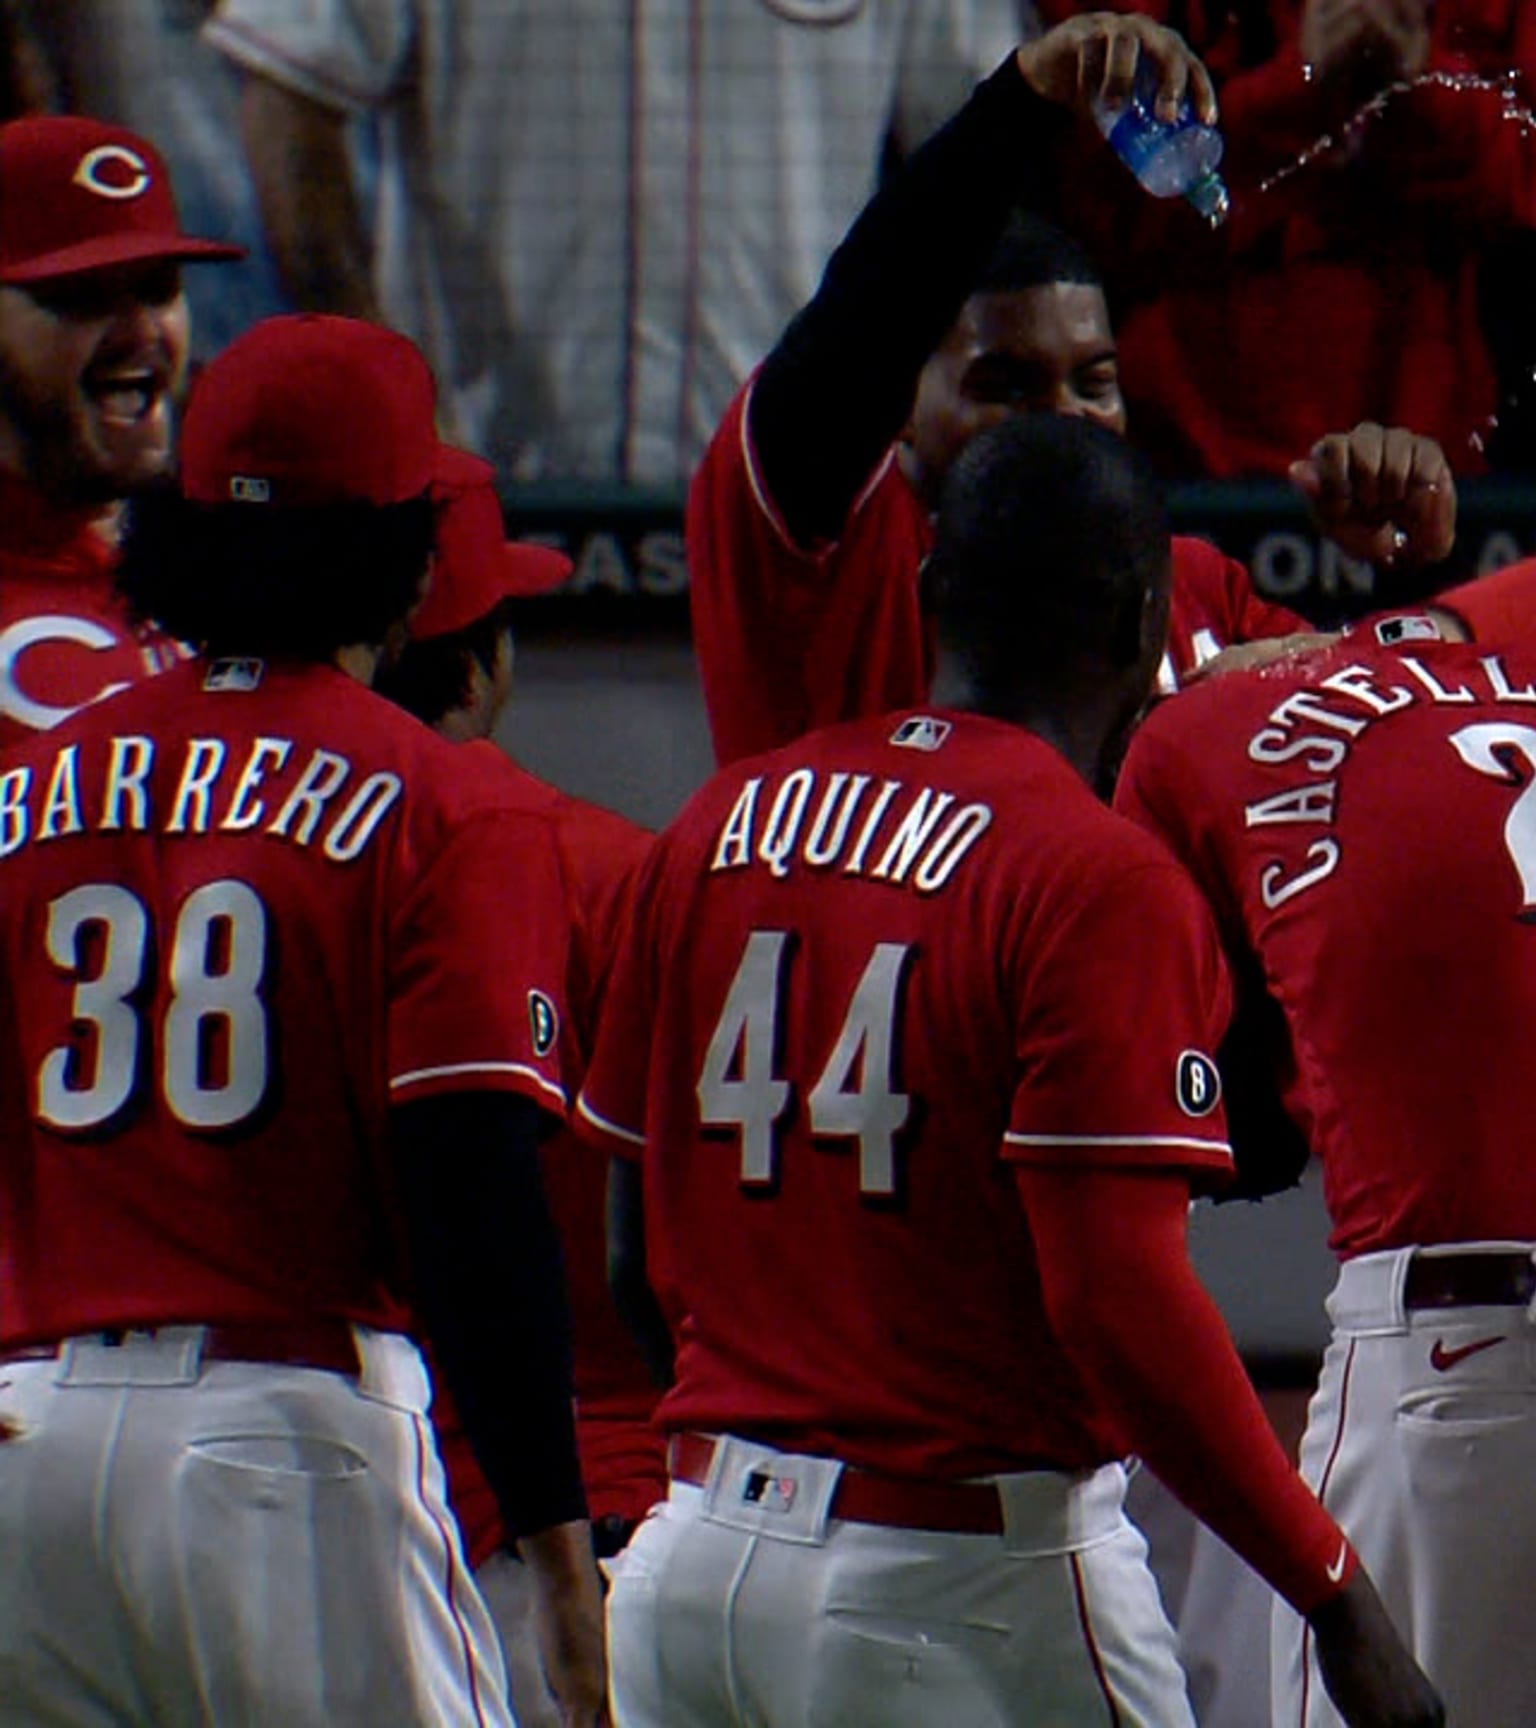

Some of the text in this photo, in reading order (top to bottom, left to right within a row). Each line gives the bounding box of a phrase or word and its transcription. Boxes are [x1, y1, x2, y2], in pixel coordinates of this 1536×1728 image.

[72, 144, 152, 200] C
[516, 530, 690, 597] AS
[1250, 530, 1376, 597] ON
[0, 735, 402, 862] BARRERO
[709, 767, 993, 892] AQUINO
[37, 878, 272, 1132] 38
[696, 929, 910, 1196] 44
[1189, 1060, 1207, 1106] 8
